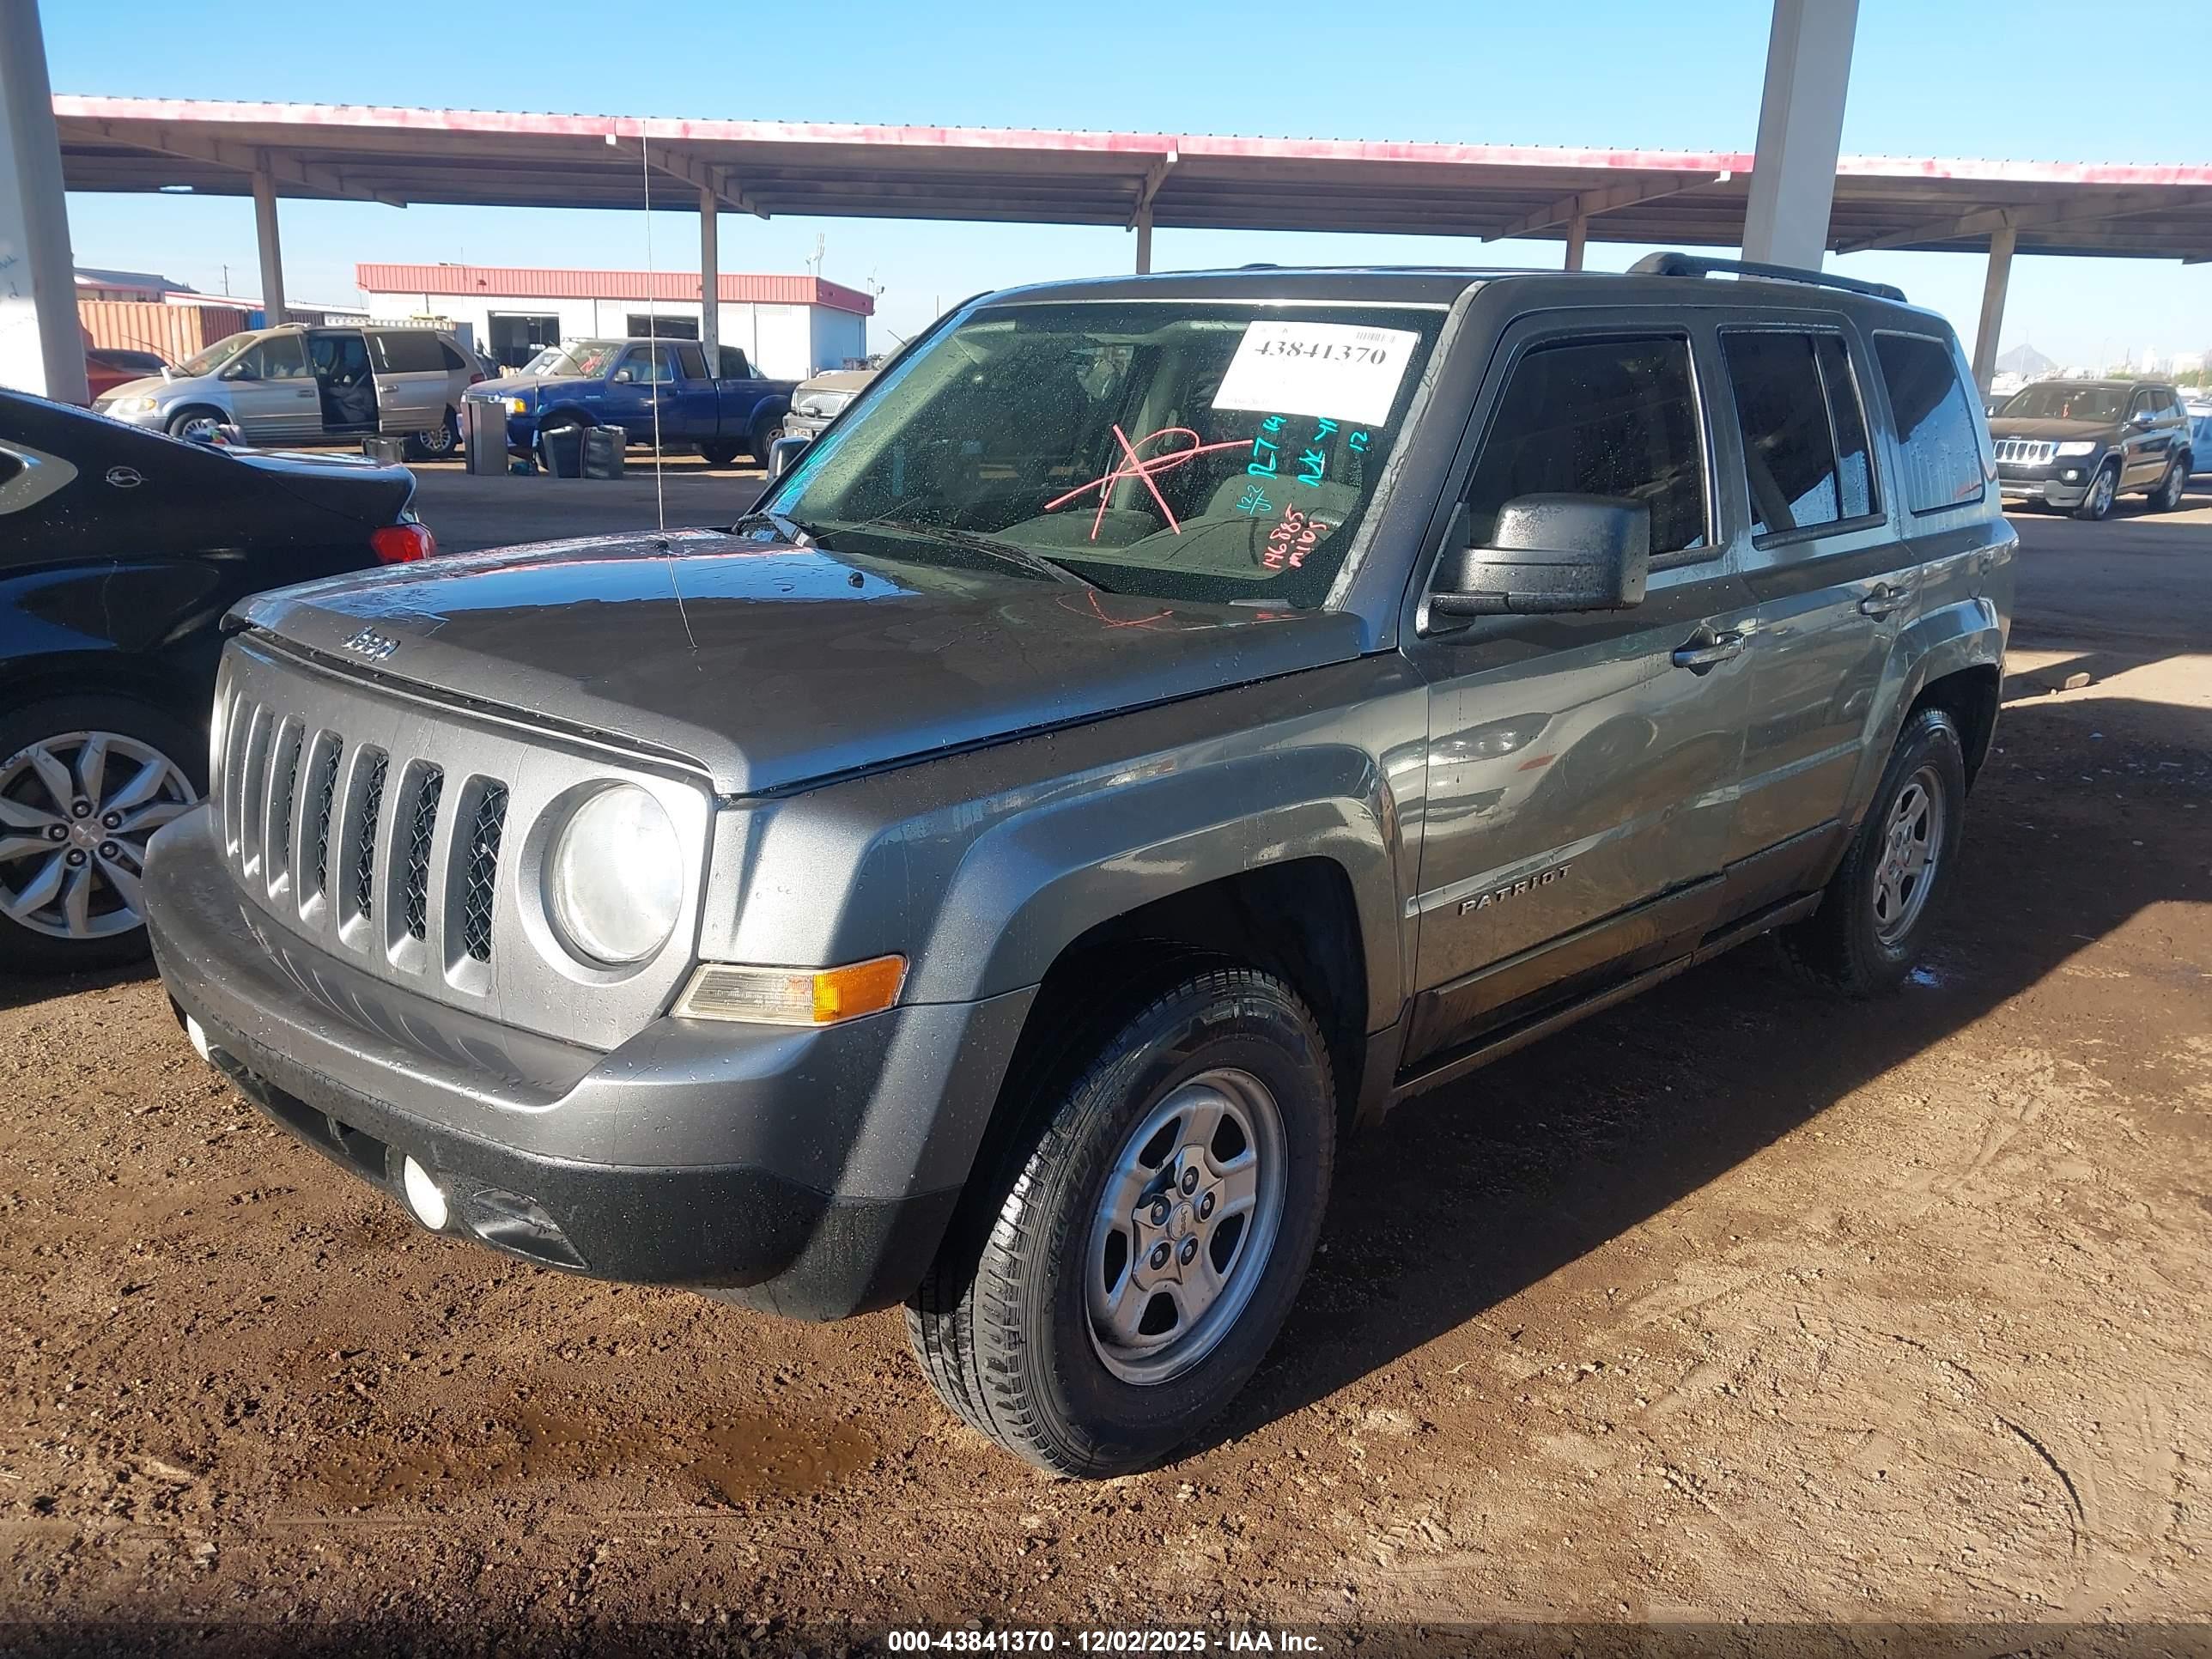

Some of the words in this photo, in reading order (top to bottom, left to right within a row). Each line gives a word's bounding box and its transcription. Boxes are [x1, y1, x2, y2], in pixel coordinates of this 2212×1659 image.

[1255, 340, 1387, 365] 43841370
[1349, 431, 1368, 452] 12
[1262, 503, 1304, 568] 146885
[1458, 863, 1573, 916] PATRIOT
